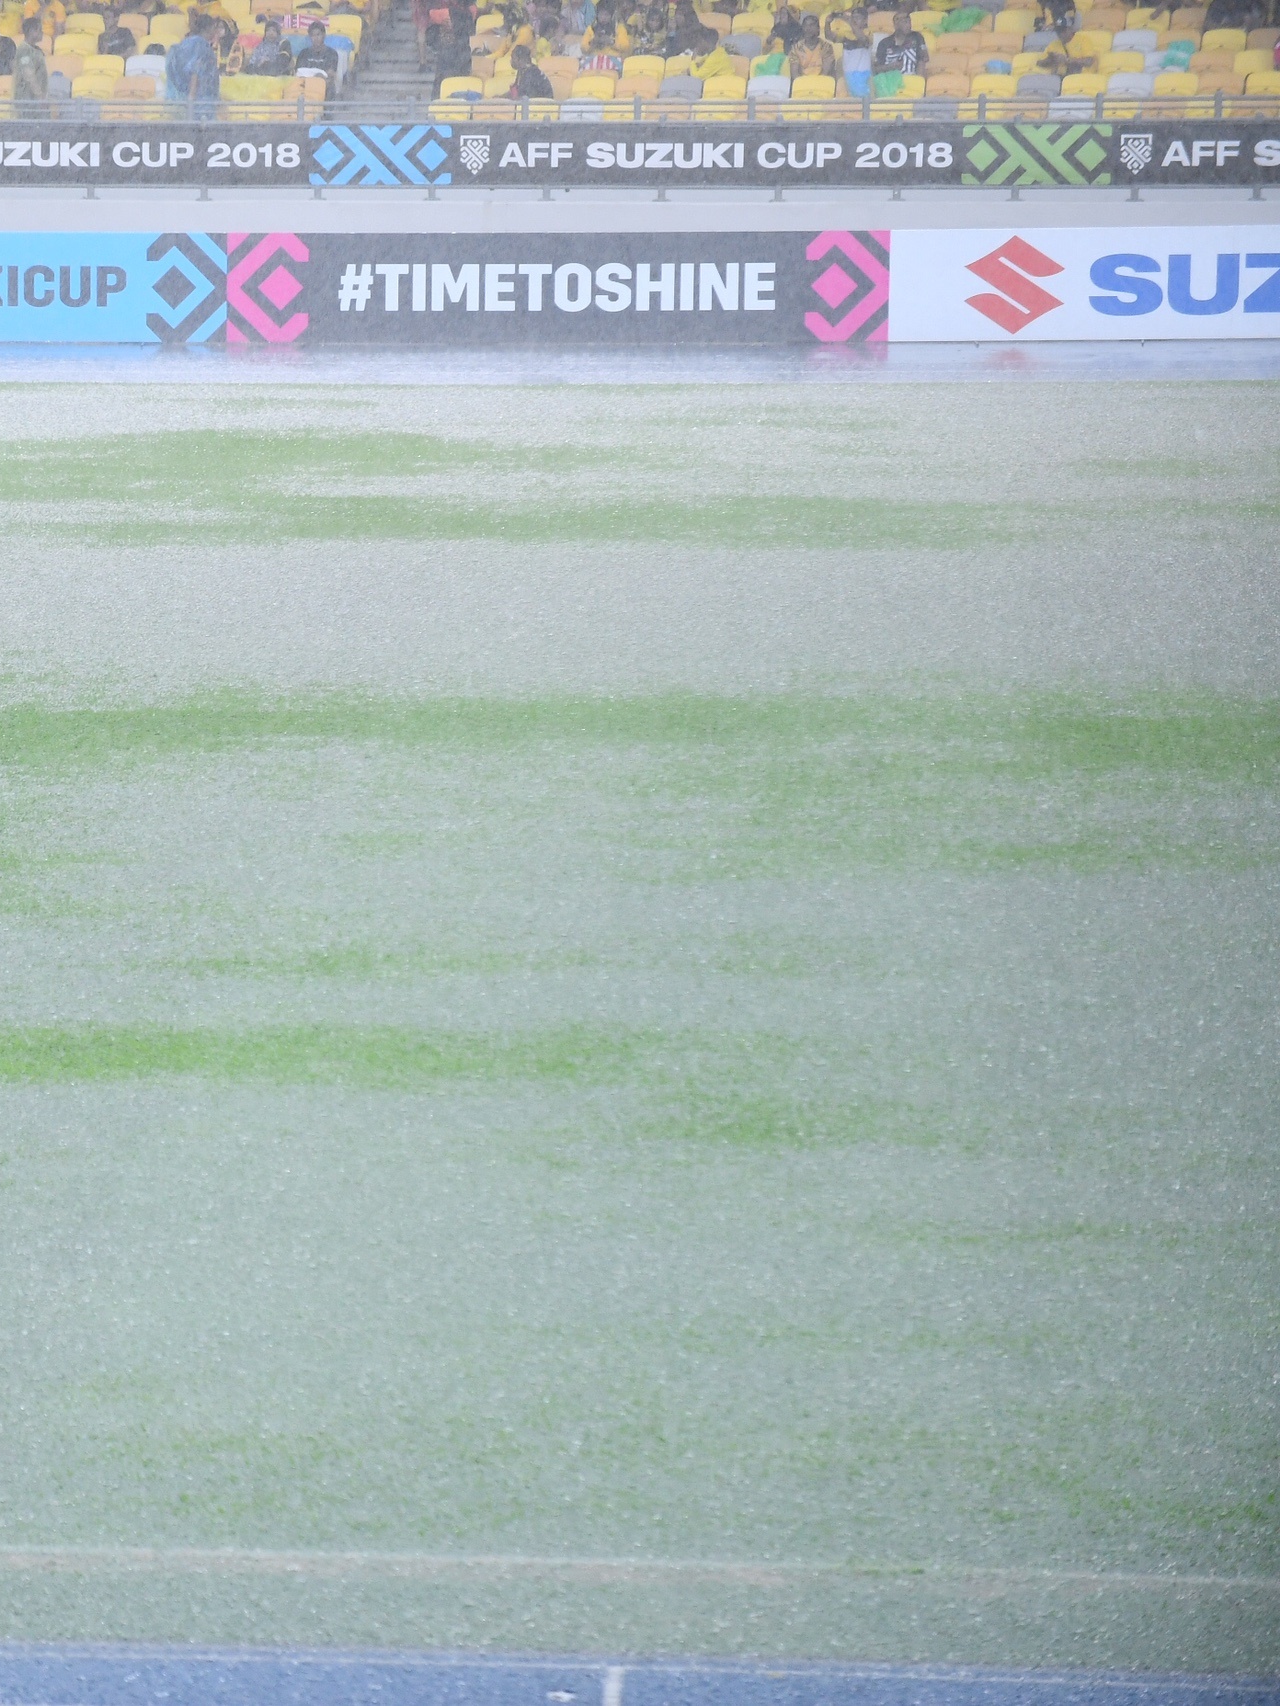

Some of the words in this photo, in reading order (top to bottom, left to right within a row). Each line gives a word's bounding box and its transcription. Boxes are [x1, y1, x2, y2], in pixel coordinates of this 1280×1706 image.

[113, 142, 194, 167] CUP
[207, 143, 300, 167] 2018
[499, 143, 573, 167] AFF
[586, 142, 744, 168] SUZUKI
[757, 142, 842, 168] CUP
[855, 142, 953, 168] 2018
[1161, 141, 1240, 166] AFF
[338, 262, 776, 313] #TIMETOSHINE
